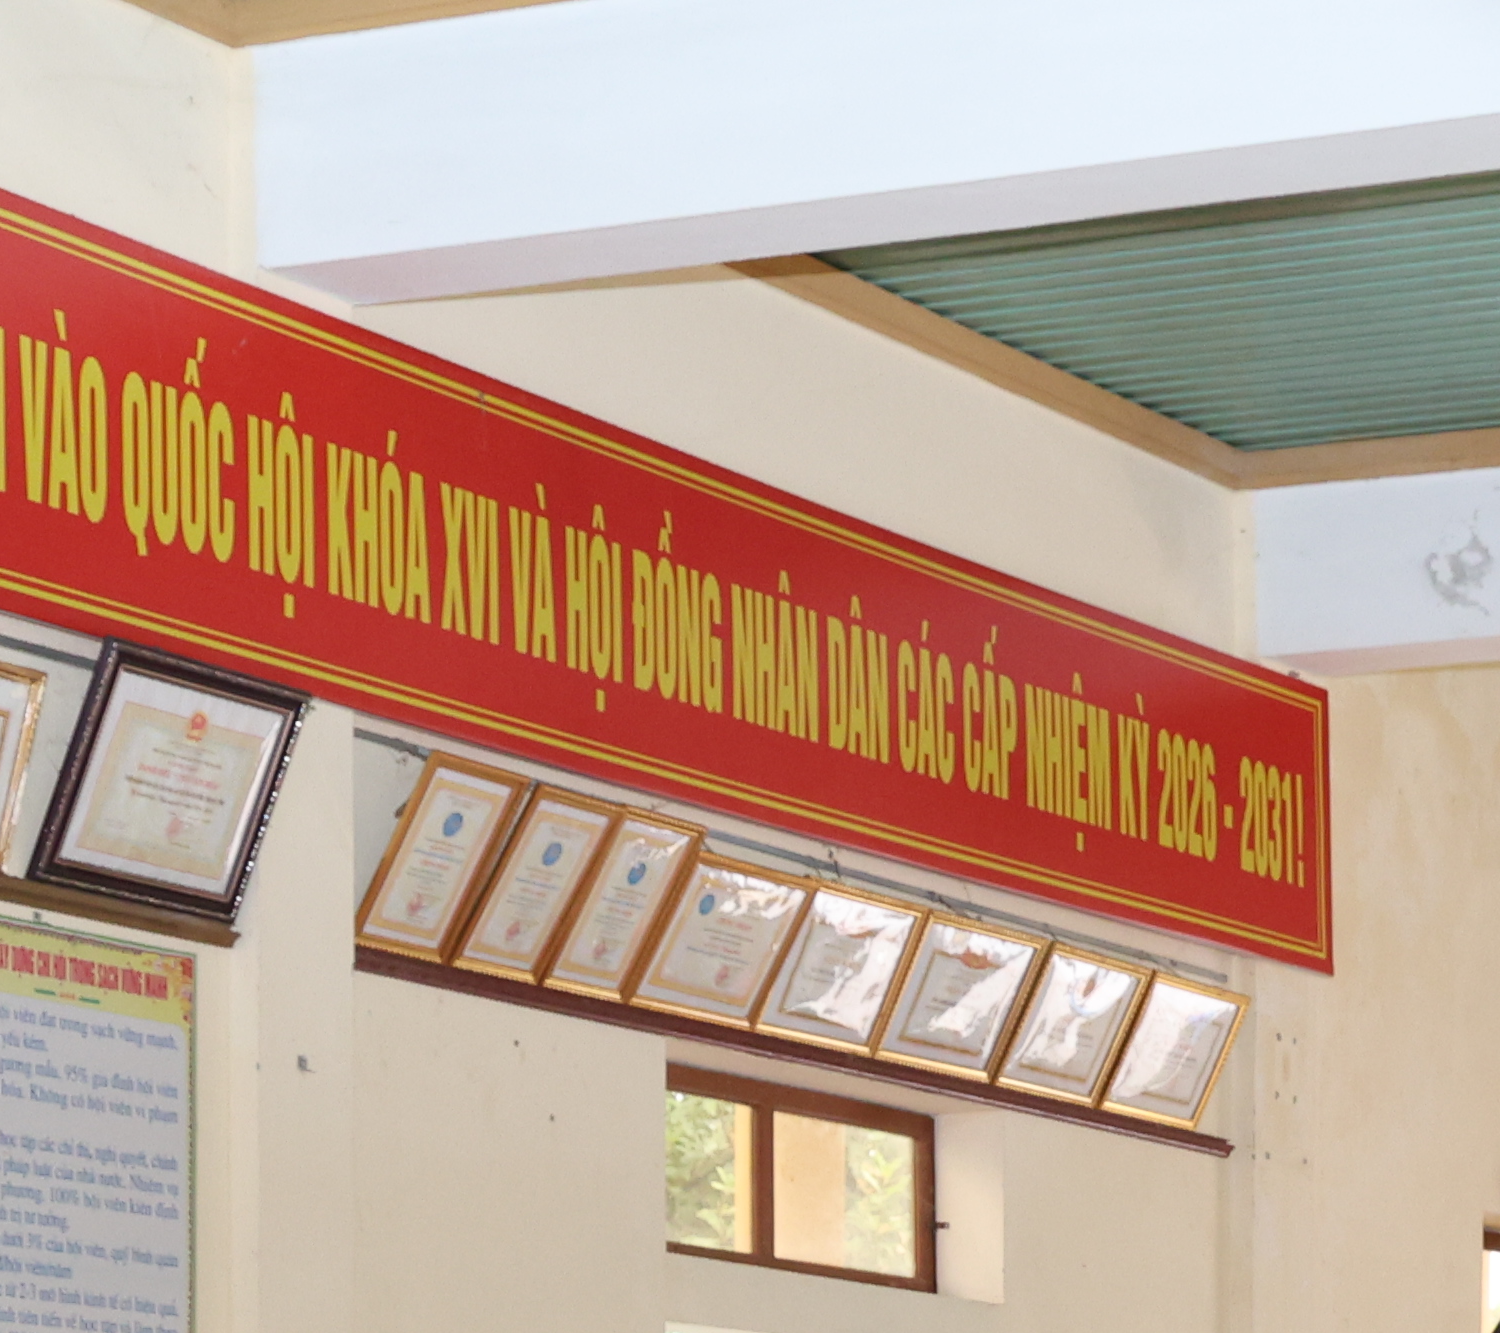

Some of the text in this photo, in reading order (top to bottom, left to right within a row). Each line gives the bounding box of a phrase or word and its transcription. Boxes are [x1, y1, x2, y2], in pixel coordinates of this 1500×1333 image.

[20, 310, 107, 522] VÀO
[123, 337, 234, 561] QUỐC
[248, 393, 314, 617] HỘI
[328, 431, 430, 622] KHÓA
[442, 483, 499, 643] XVI
[510, 484, 555, 661] VÀ
[566, 505, 622, 710] HỘI
[633, 511, 722, 712] ĐỒNG
[732, 572, 818, 740] NHÂN
[828, 597, 888, 762] DÂN
[899, 623, 953, 782] CÁC
[964, 625, 1016, 798] CẤP
[1026, 675, 1110, 849] NHIỆM
[1119, 697, 1148, 838] KỲ
[1159, 730, 1216, 860] 2026
[1225, 807, 1232, 827] -
[1241, 758, 1303, 885] 2031!
